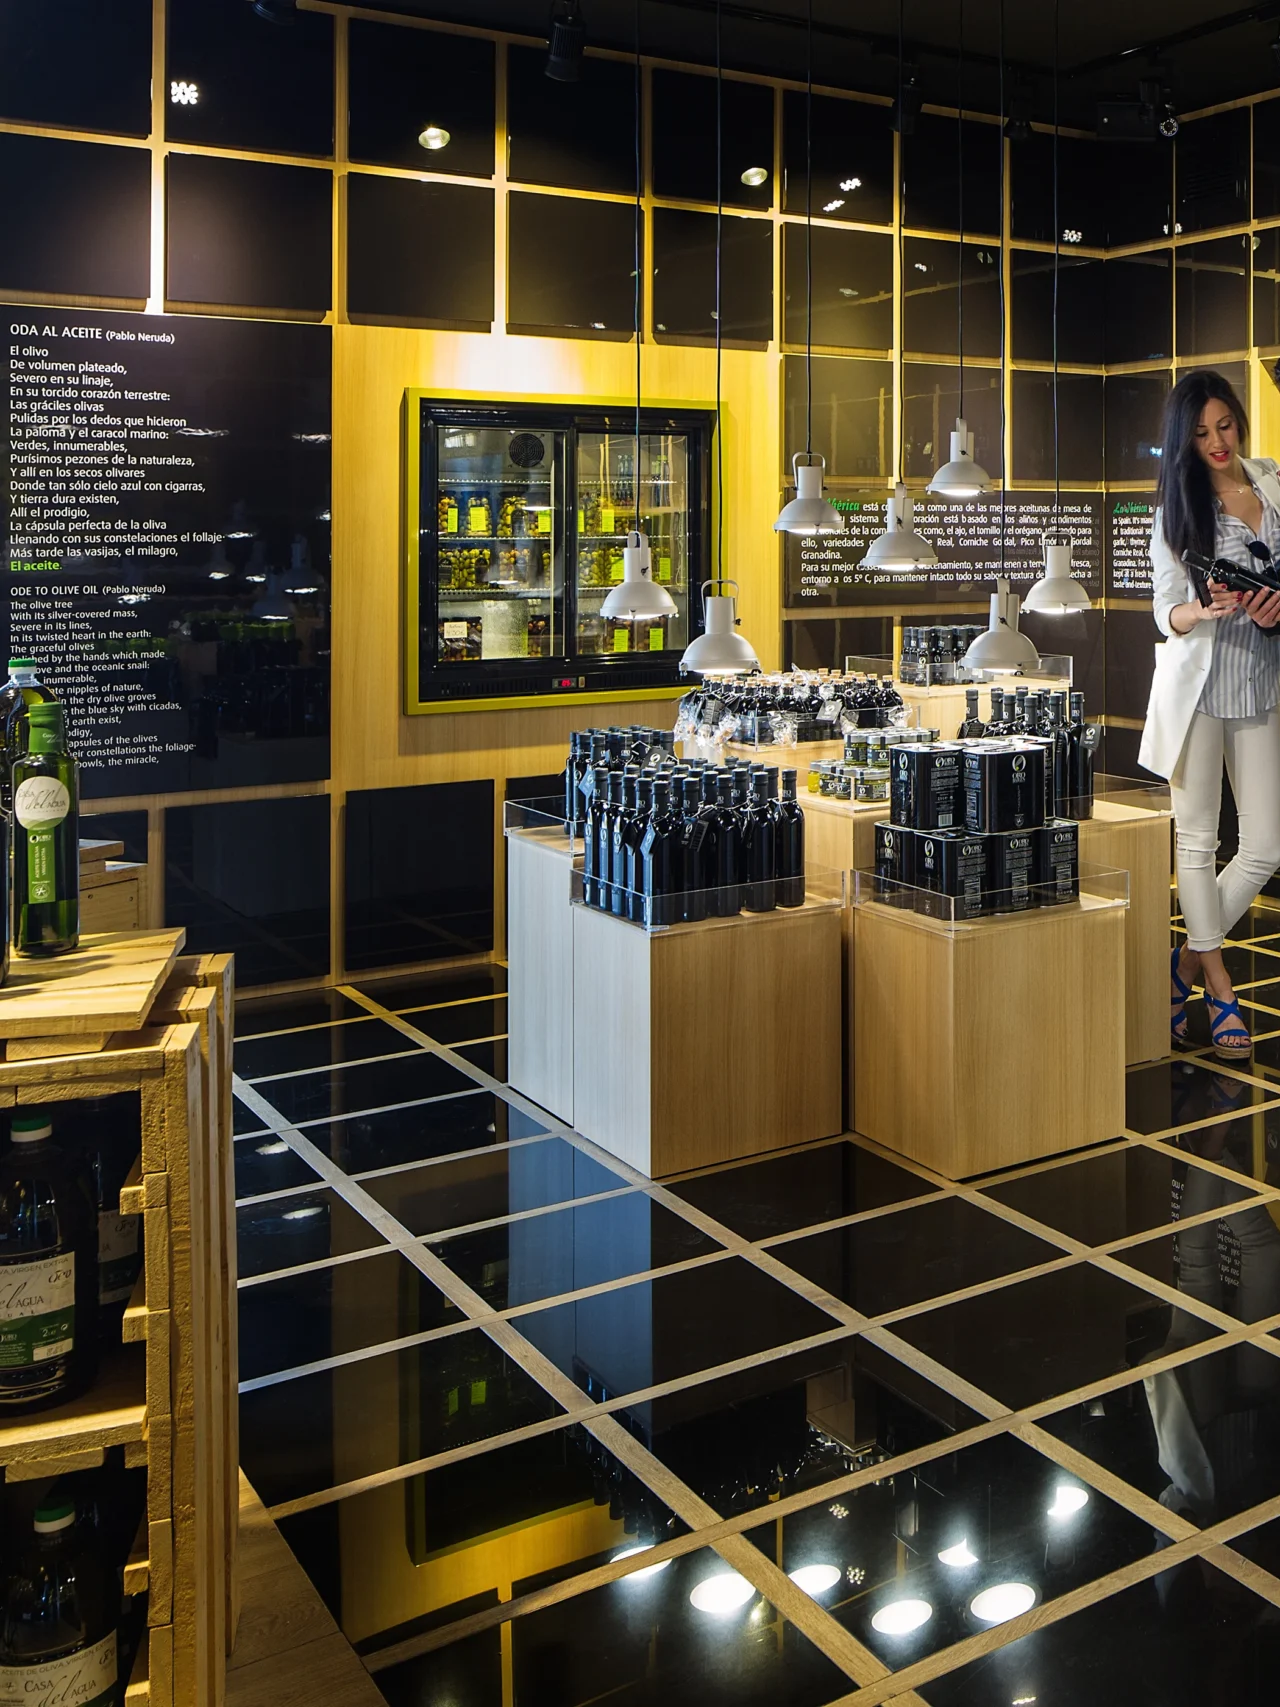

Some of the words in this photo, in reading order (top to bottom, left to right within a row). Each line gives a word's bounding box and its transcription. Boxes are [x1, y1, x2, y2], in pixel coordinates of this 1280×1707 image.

[10, 323, 39, 336] ODA
[42, 325, 58, 337] AL
[61, 326, 102, 339] ACEITE
[105, 330, 136, 342] (Pablo
[137, 332, 175, 345] Neruda)
[10, 345, 19, 356] El
[22, 345, 49, 357] olivo
[10, 359, 25, 370] De
[28, 359, 76, 372] volumen
[78, 361, 128, 375] plateado,
[10, 372, 48, 384] Severo
[50, 375, 64, 384] en
[66, 376, 79, 385] su
[82, 374, 114, 388] linaje,
[10, 386, 23, 396] En
[26, 388, 39, 397] su
[41, 387, 79, 398] torcido
[80, 388, 122, 399] corazón
[124, 390, 171, 401] terrestre:
[10, 399, 28, 410] Las
[30, 400, 72, 413] gráciles
[73, 400, 105, 412] olivas
[10, 412, 49, 424] Pulidas
[52, 416, 70, 427] por
[72, 413, 88, 425] los
[90, 414, 122, 426] dedos
[124, 417, 144, 428] que
[146, 415, 187, 427] hicieron
[9, 439, 50, 452] Verdes,
[53, 440, 128, 453] innumerables,
[10, 479, 46, 491] Donde
[48, 481, 66, 491] tan
[69, 479, 91, 491] sólo
[93, 480, 118, 491] cielo
[120, 480, 141, 491] azul
[143, 482, 162, 491] con
[164, 481, 206, 493] cigarras,
[863, 503, 878, 512] está
[965, 503, 975, 512] de
[977, 503, 987, 512] las
[849, 515, 879, 523] sistema
[943, 514, 959, 523] está
[1018, 515, 1039, 523] aliños
[1077, 528, 1092, 537] para
[801, 539, 818, 549] ello,
[823, 538, 864, 547] variedades
[937, 538, 954, 548] Real,
[801, 551, 843, 560] Granadina.
[10, 560, 21, 571] El
[23, 561, 62, 571] aceite.
[801, 563, 819, 572] Para
[832, 563, 855, 574] mejor
[873, 576, 891, 585] para
[892, 574, 928, 583] mantener
[956, 571, 972, 581] todo
[10, 586, 32, 597] ODE
[34, 586, 48, 596] TO
[51, 585, 80, 595] OLIVE
[82, 585, 99, 595] OIL
[102, 585, 130, 596] (Pablo
[132, 584, 166, 595] Neruda)
[801, 588, 819, 596] otra.
[10, 601, 27, 610] The
[29, 600, 52, 610] olive
[54, 601, 73, 609] tree
[10, 611, 32, 621] With
[34, 612, 45, 620] its
[47, 609, 111, 620] silver-covered
[112, 610, 138, 618] mass,
[10, 623, 42, 632] Severe
[44, 622, 53, 631] in
[55, 622, 67, 630] its
[69, 621, 93, 630] lines,
[69, 696, 85, 705] the
[86, 695, 102, 705] dry
[103, 694, 125, 703] olive
[127, 693, 157, 704] groves
[108, 757, 123, 766] the
[125, 754, 159, 765] miracle,
[15, 1295, 44, 1309] AGUA
[70, 1679, 97, 1698] AGUA
